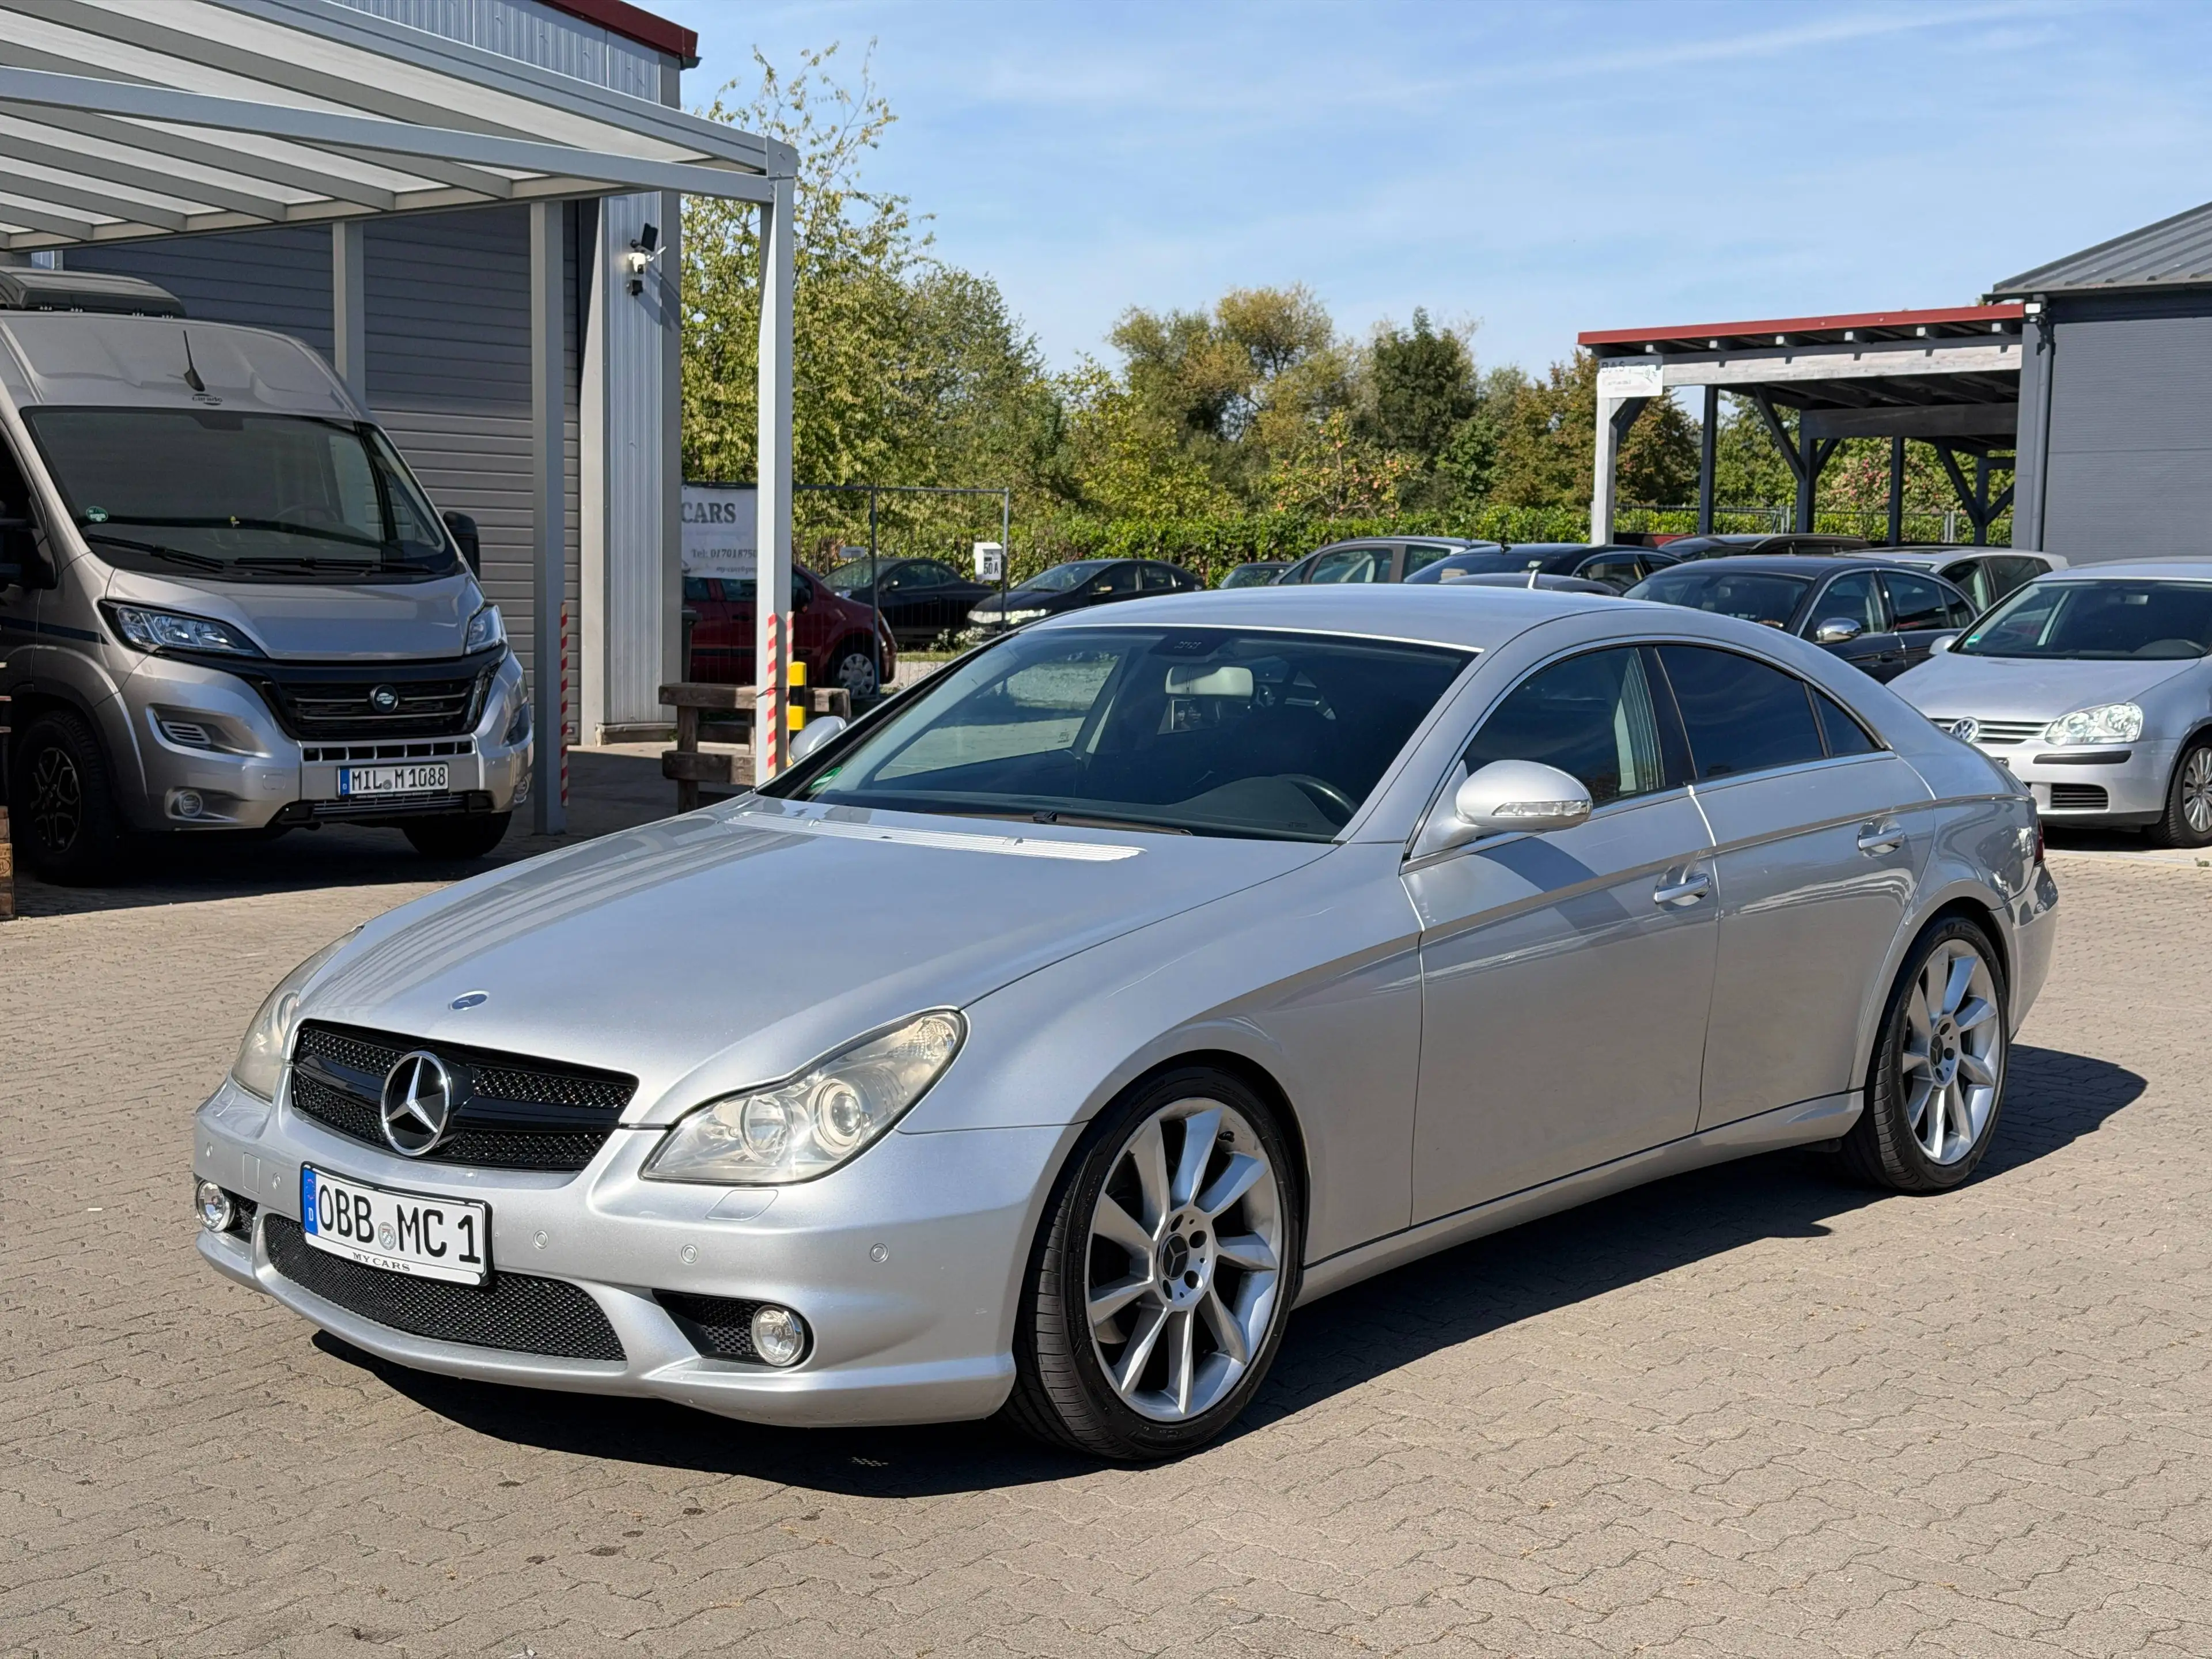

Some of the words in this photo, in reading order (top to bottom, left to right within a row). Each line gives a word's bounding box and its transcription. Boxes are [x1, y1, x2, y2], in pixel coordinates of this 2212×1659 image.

[681, 502, 737, 524] CARS
[691, 549, 708, 558] Tel:
[352, 770, 382, 791] MIL
[395, 769, 404, 789] M
[408, 767, 446, 787] 1088
[308, 1207, 314, 1221] D
[319, 1184, 374, 1243] OBB
[396, 1204, 447, 1257] MC
[457, 1215, 481, 1264] 1
[352, 1252, 370, 1264] MY
[373, 1257, 411, 1272] CARS
